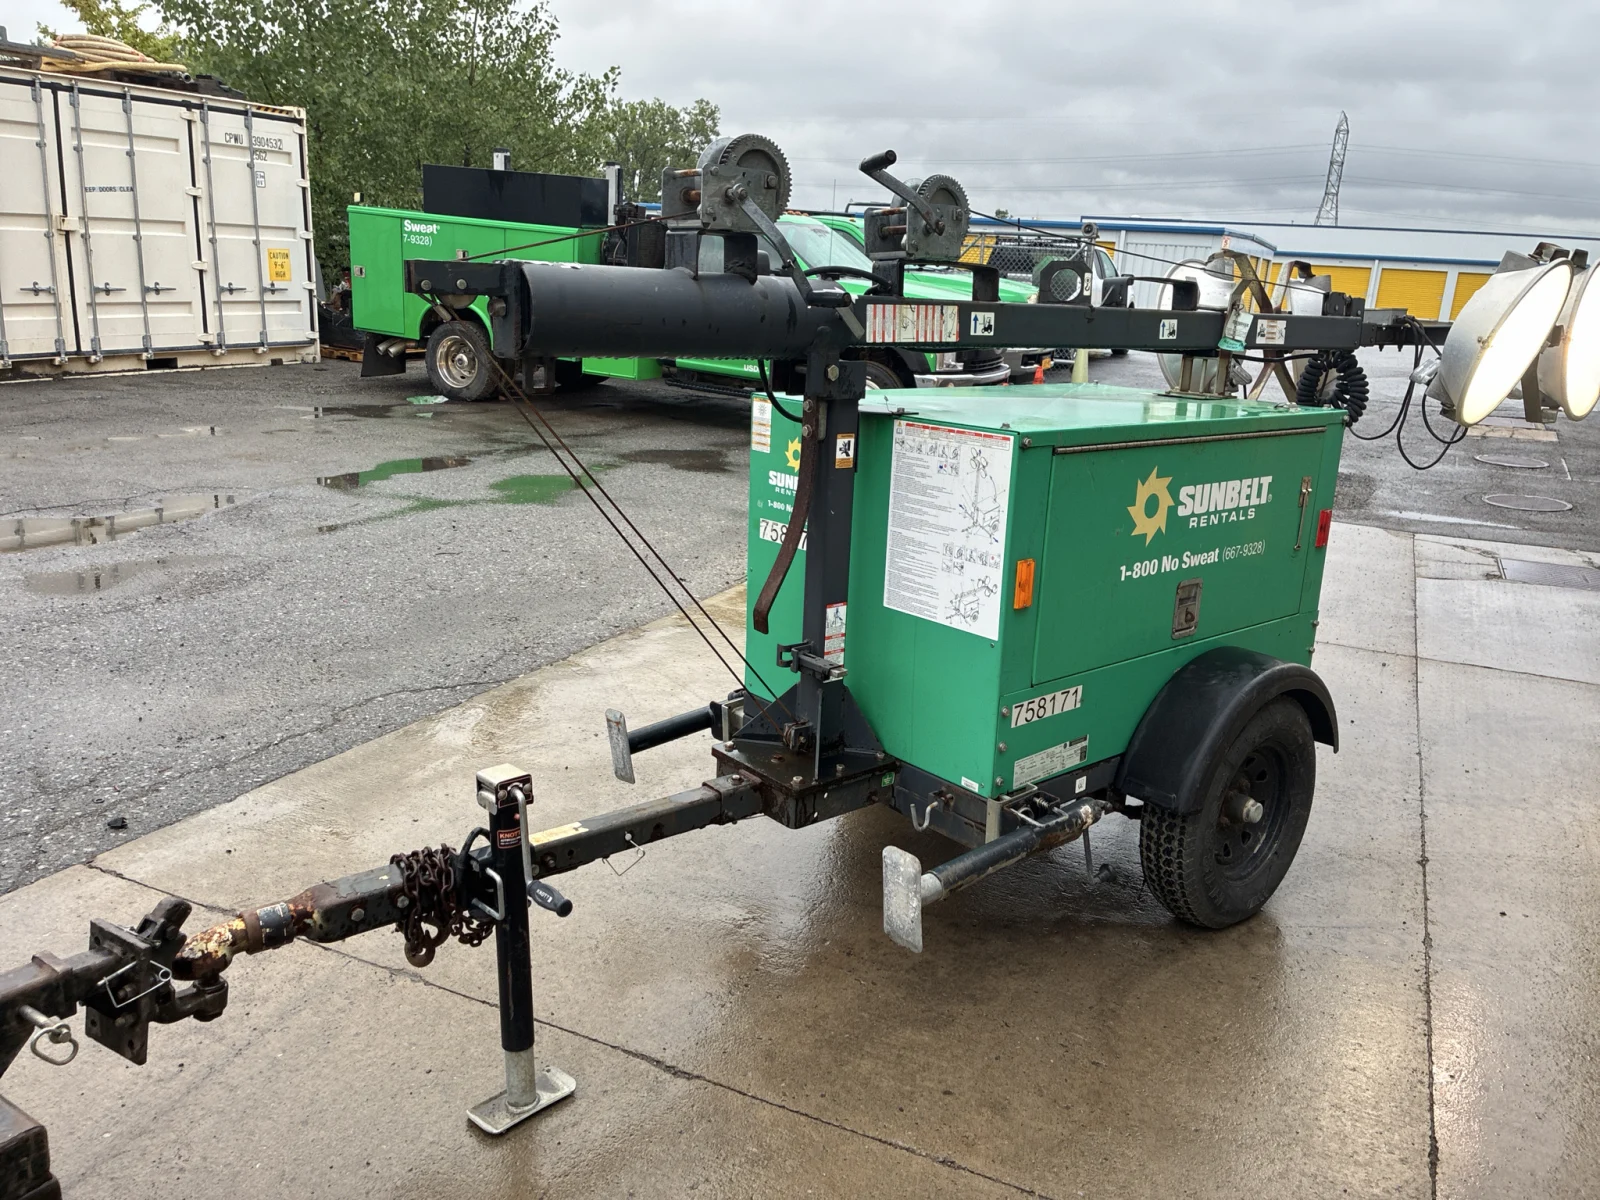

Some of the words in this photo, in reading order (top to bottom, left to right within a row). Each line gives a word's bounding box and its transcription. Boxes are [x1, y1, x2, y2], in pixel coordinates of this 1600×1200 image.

[225, 133, 243, 145] CPWU
[404, 220, 437, 234] Sweat
[275, 270, 286, 278] HIGH
[775, 487, 797, 497] RENT
[1177, 476, 1272, 516] SUNBELT
[768, 500, 785, 510] 1-800
[1189, 508, 1256, 529] RENTALS
[1120, 559, 1158, 581] 1-800
[1161, 554, 1178, 573] No
[1182, 548, 1219, 569] Sweat
[1222, 539, 1266, 562] (667-9328)
[1013, 687, 1079, 727] 758171
